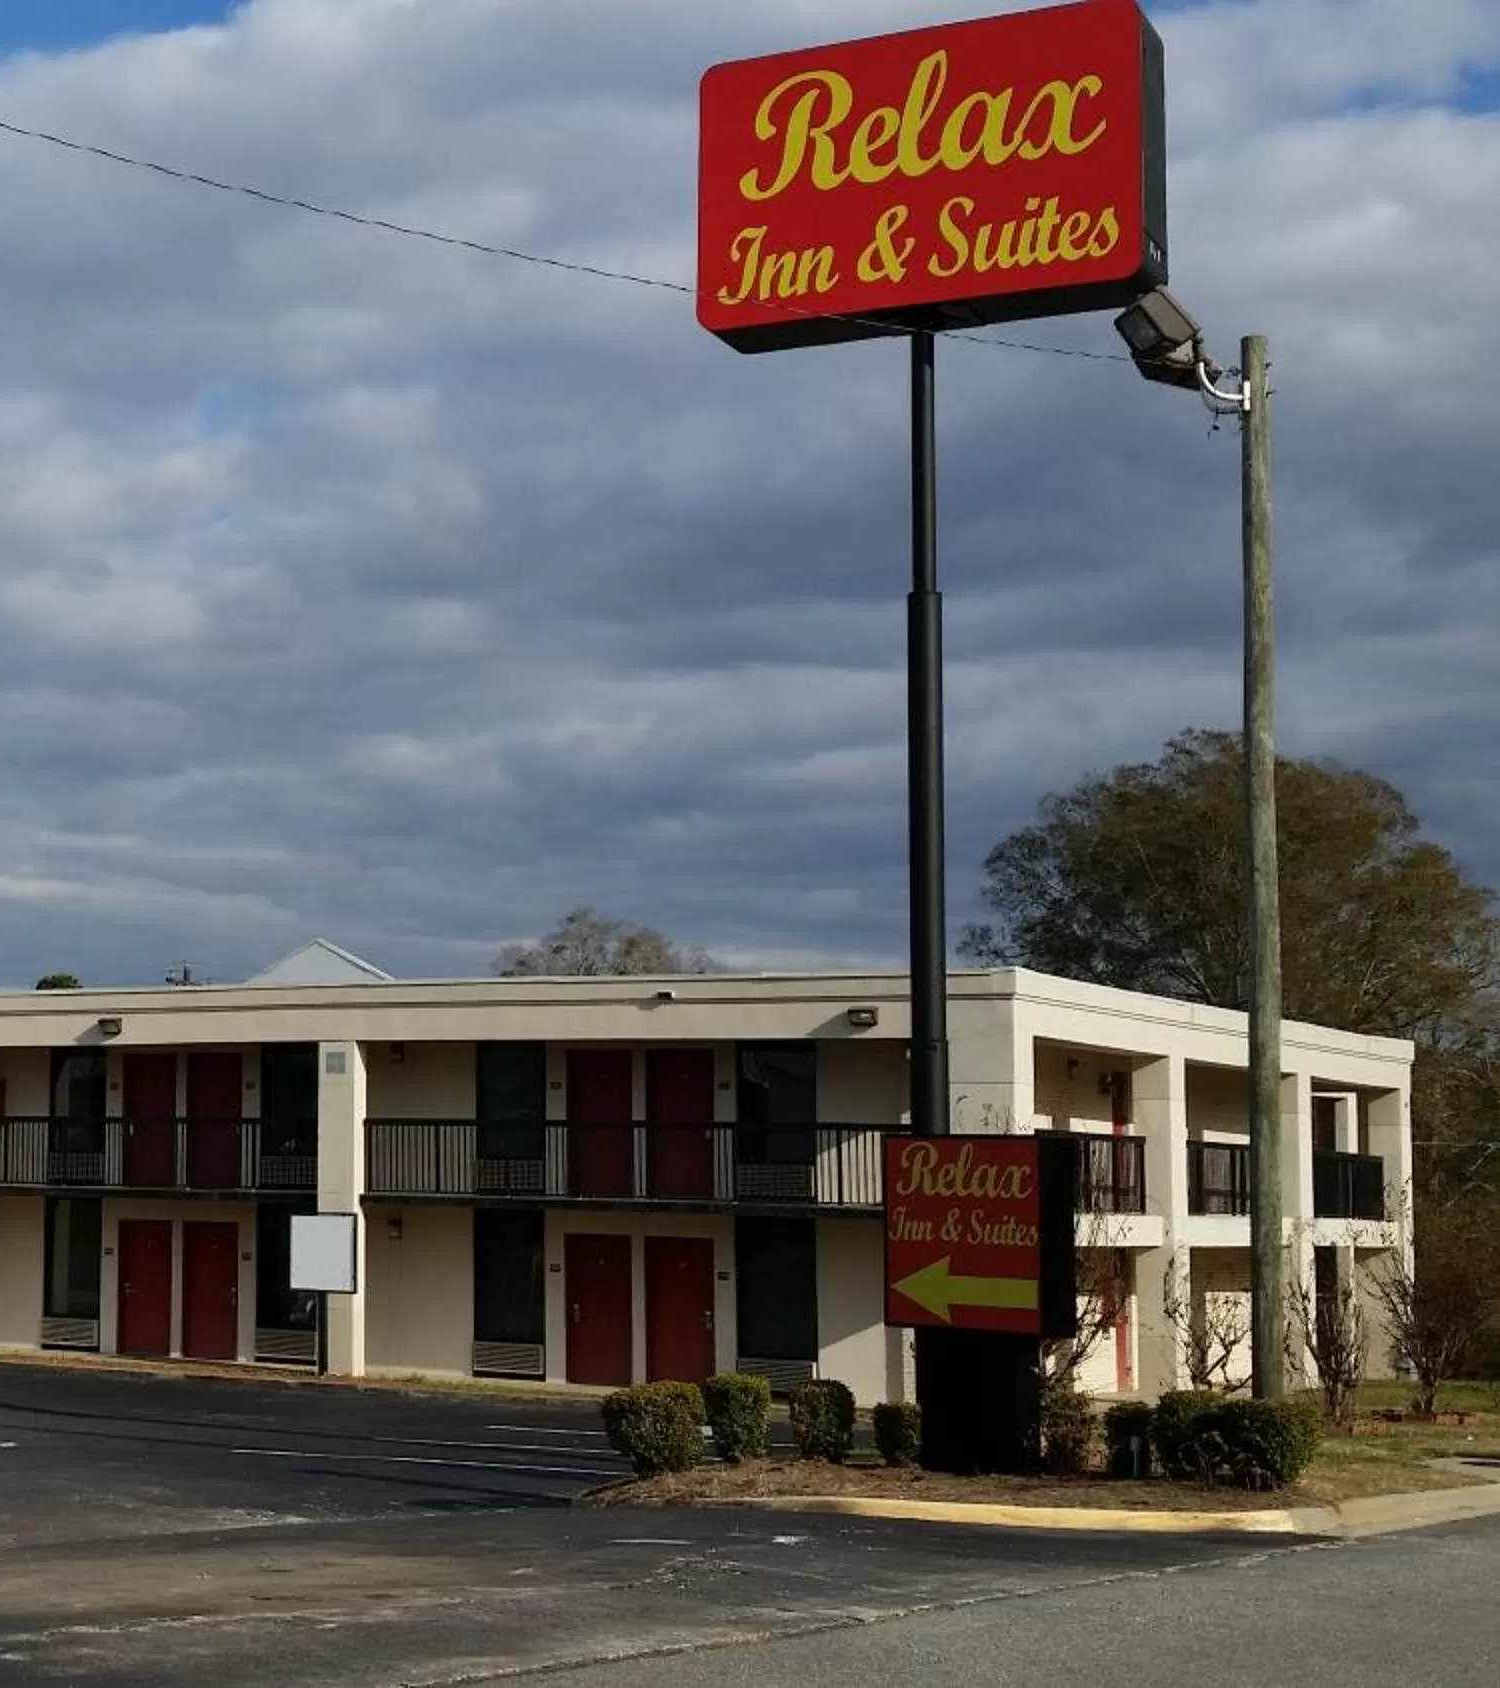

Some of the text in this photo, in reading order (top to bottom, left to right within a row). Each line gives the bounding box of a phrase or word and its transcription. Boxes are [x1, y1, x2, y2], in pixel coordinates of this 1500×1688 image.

[739, 49, 1106, 200] Relax
[717, 196, 1120, 305] Inn & Suites
[895, 1141, 1033, 1199] Relax
[888, 1206, 1039, 1246] Inn & Suites
